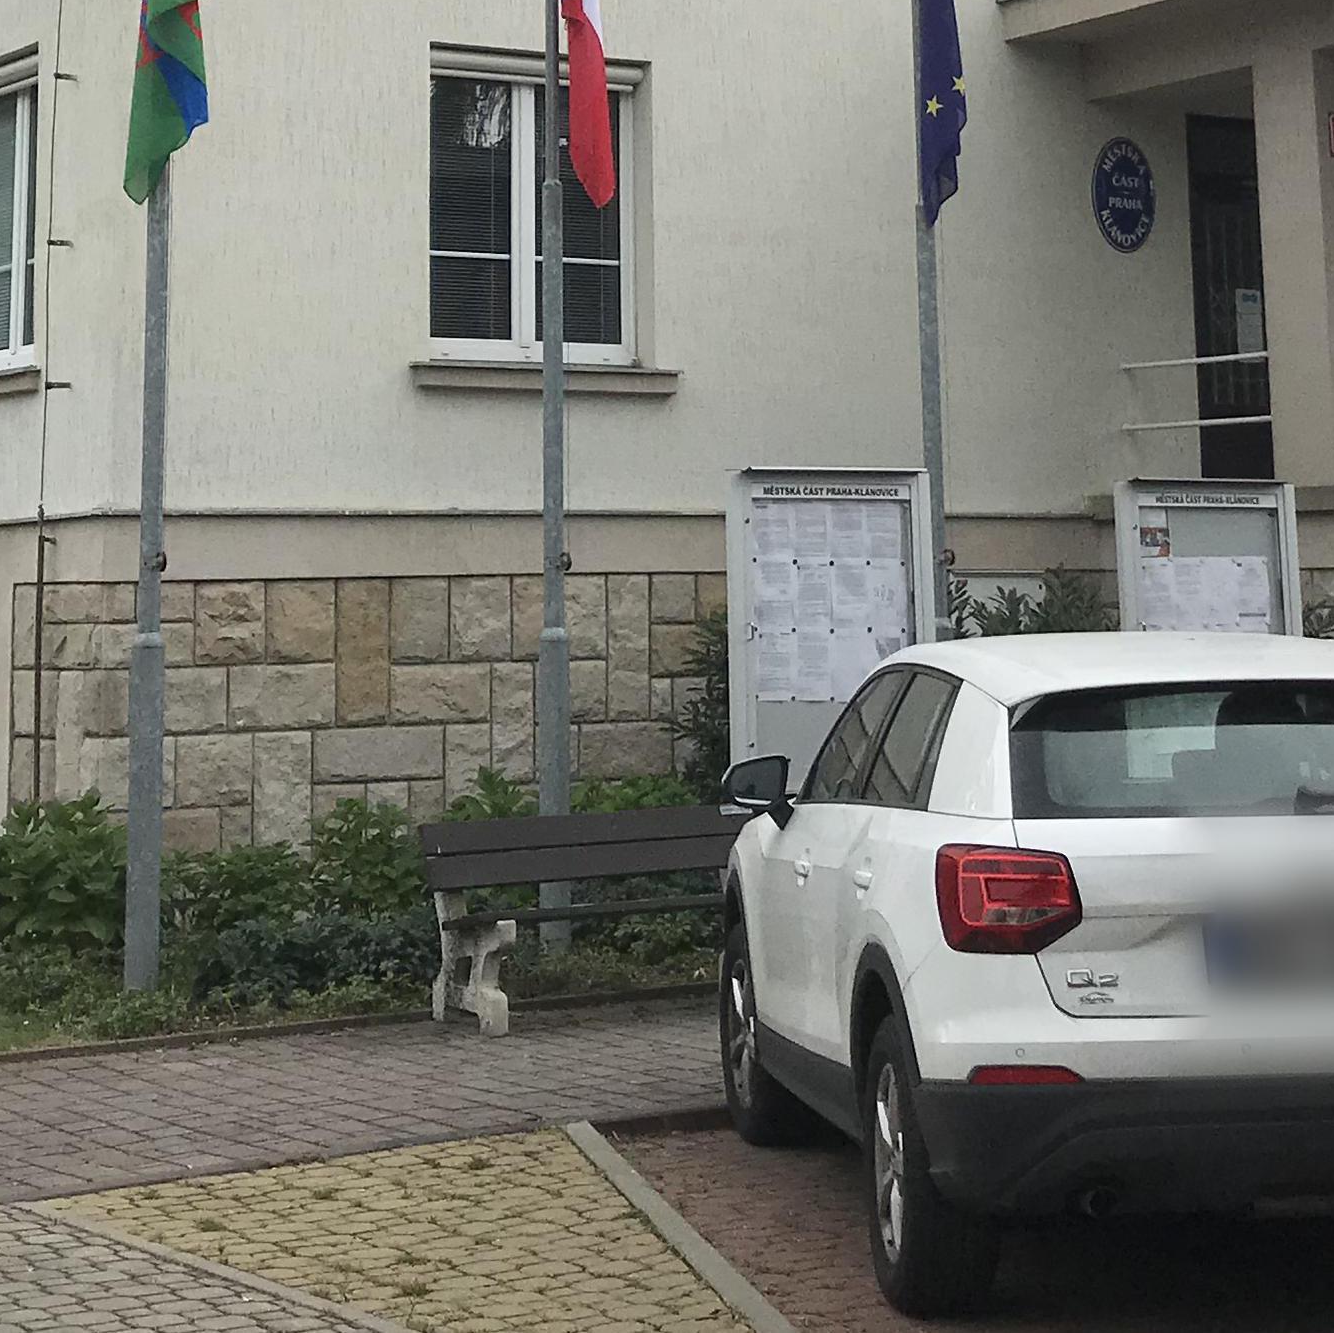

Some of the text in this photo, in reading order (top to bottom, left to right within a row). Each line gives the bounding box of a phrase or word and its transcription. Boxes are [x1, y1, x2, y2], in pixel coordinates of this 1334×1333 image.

[1108, 196, 1143, 211] PRAHA
[762, 485, 802, 497] MĚSTSKÁ
[803, 485, 824, 496] ČÁST
[1067, 968, 1119, 988] Q2
